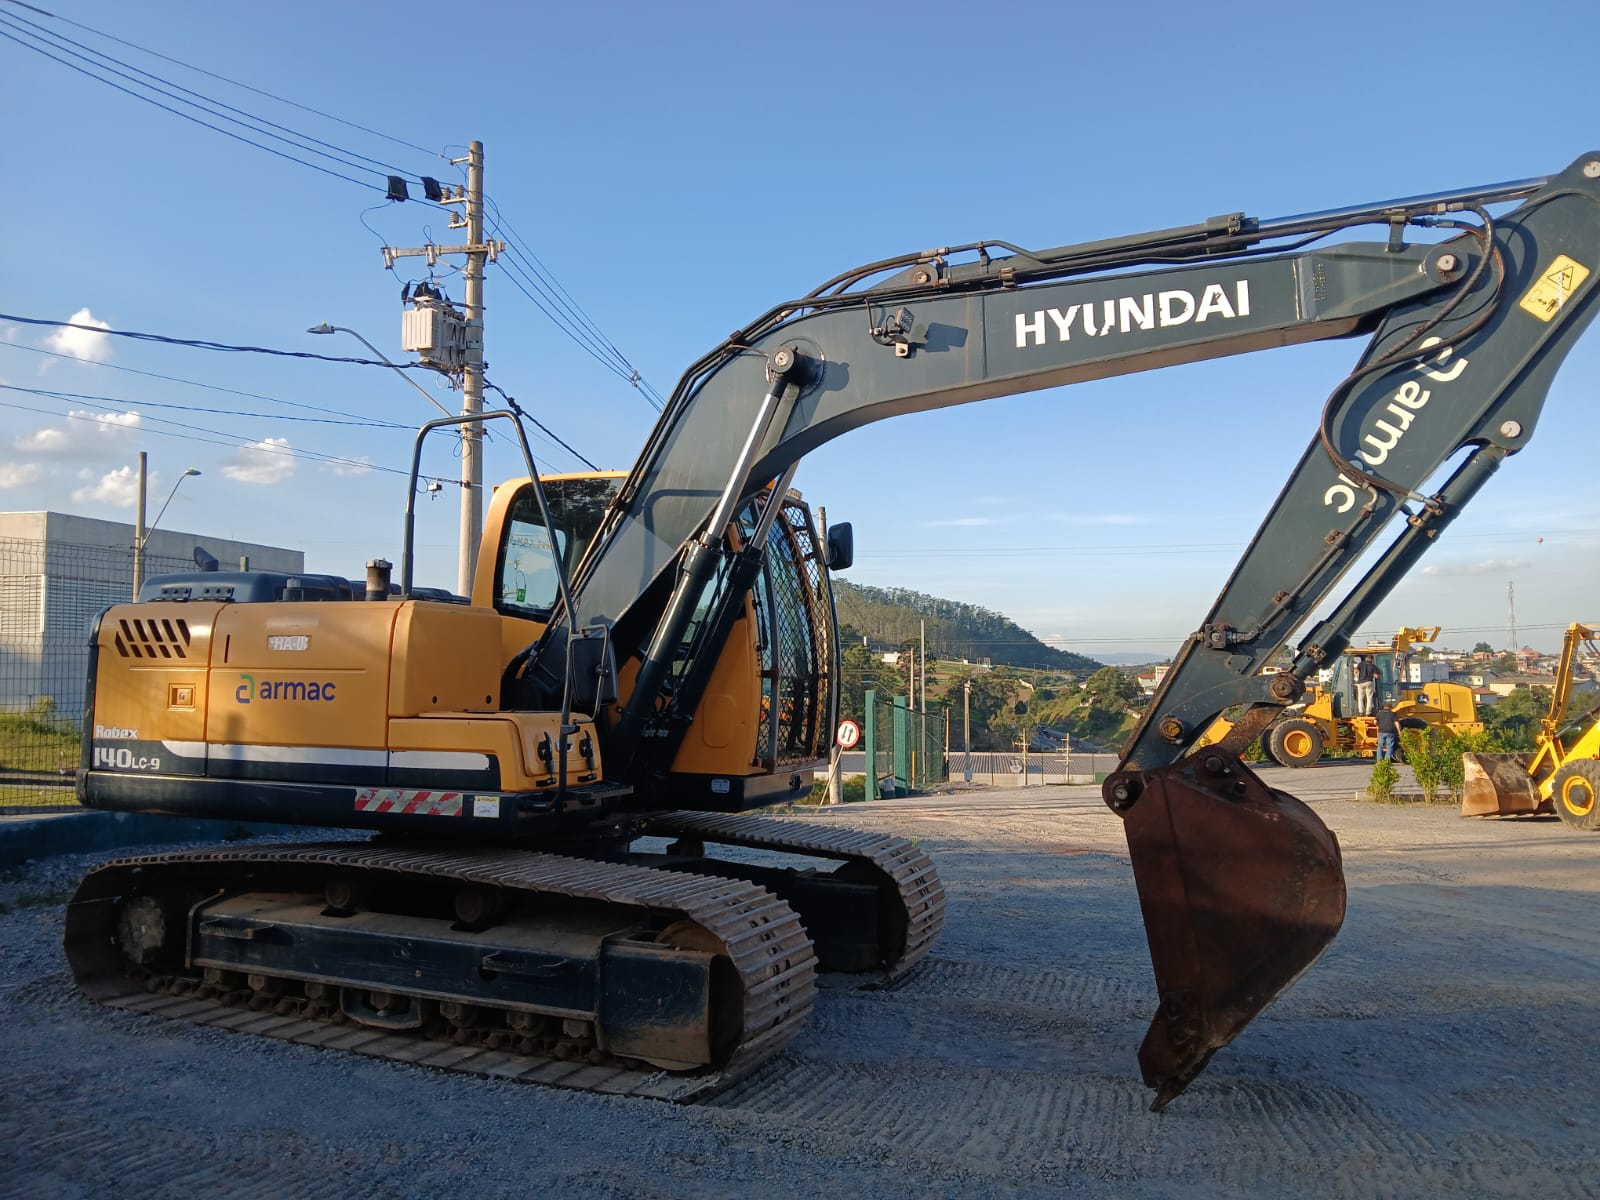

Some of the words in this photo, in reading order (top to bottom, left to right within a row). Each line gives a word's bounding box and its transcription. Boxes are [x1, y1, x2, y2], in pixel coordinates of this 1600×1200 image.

[1015, 279, 1250, 348] HYUNDAI
[259, 681, 336, 701] armac
[95, 725, 138, 739] Robex
